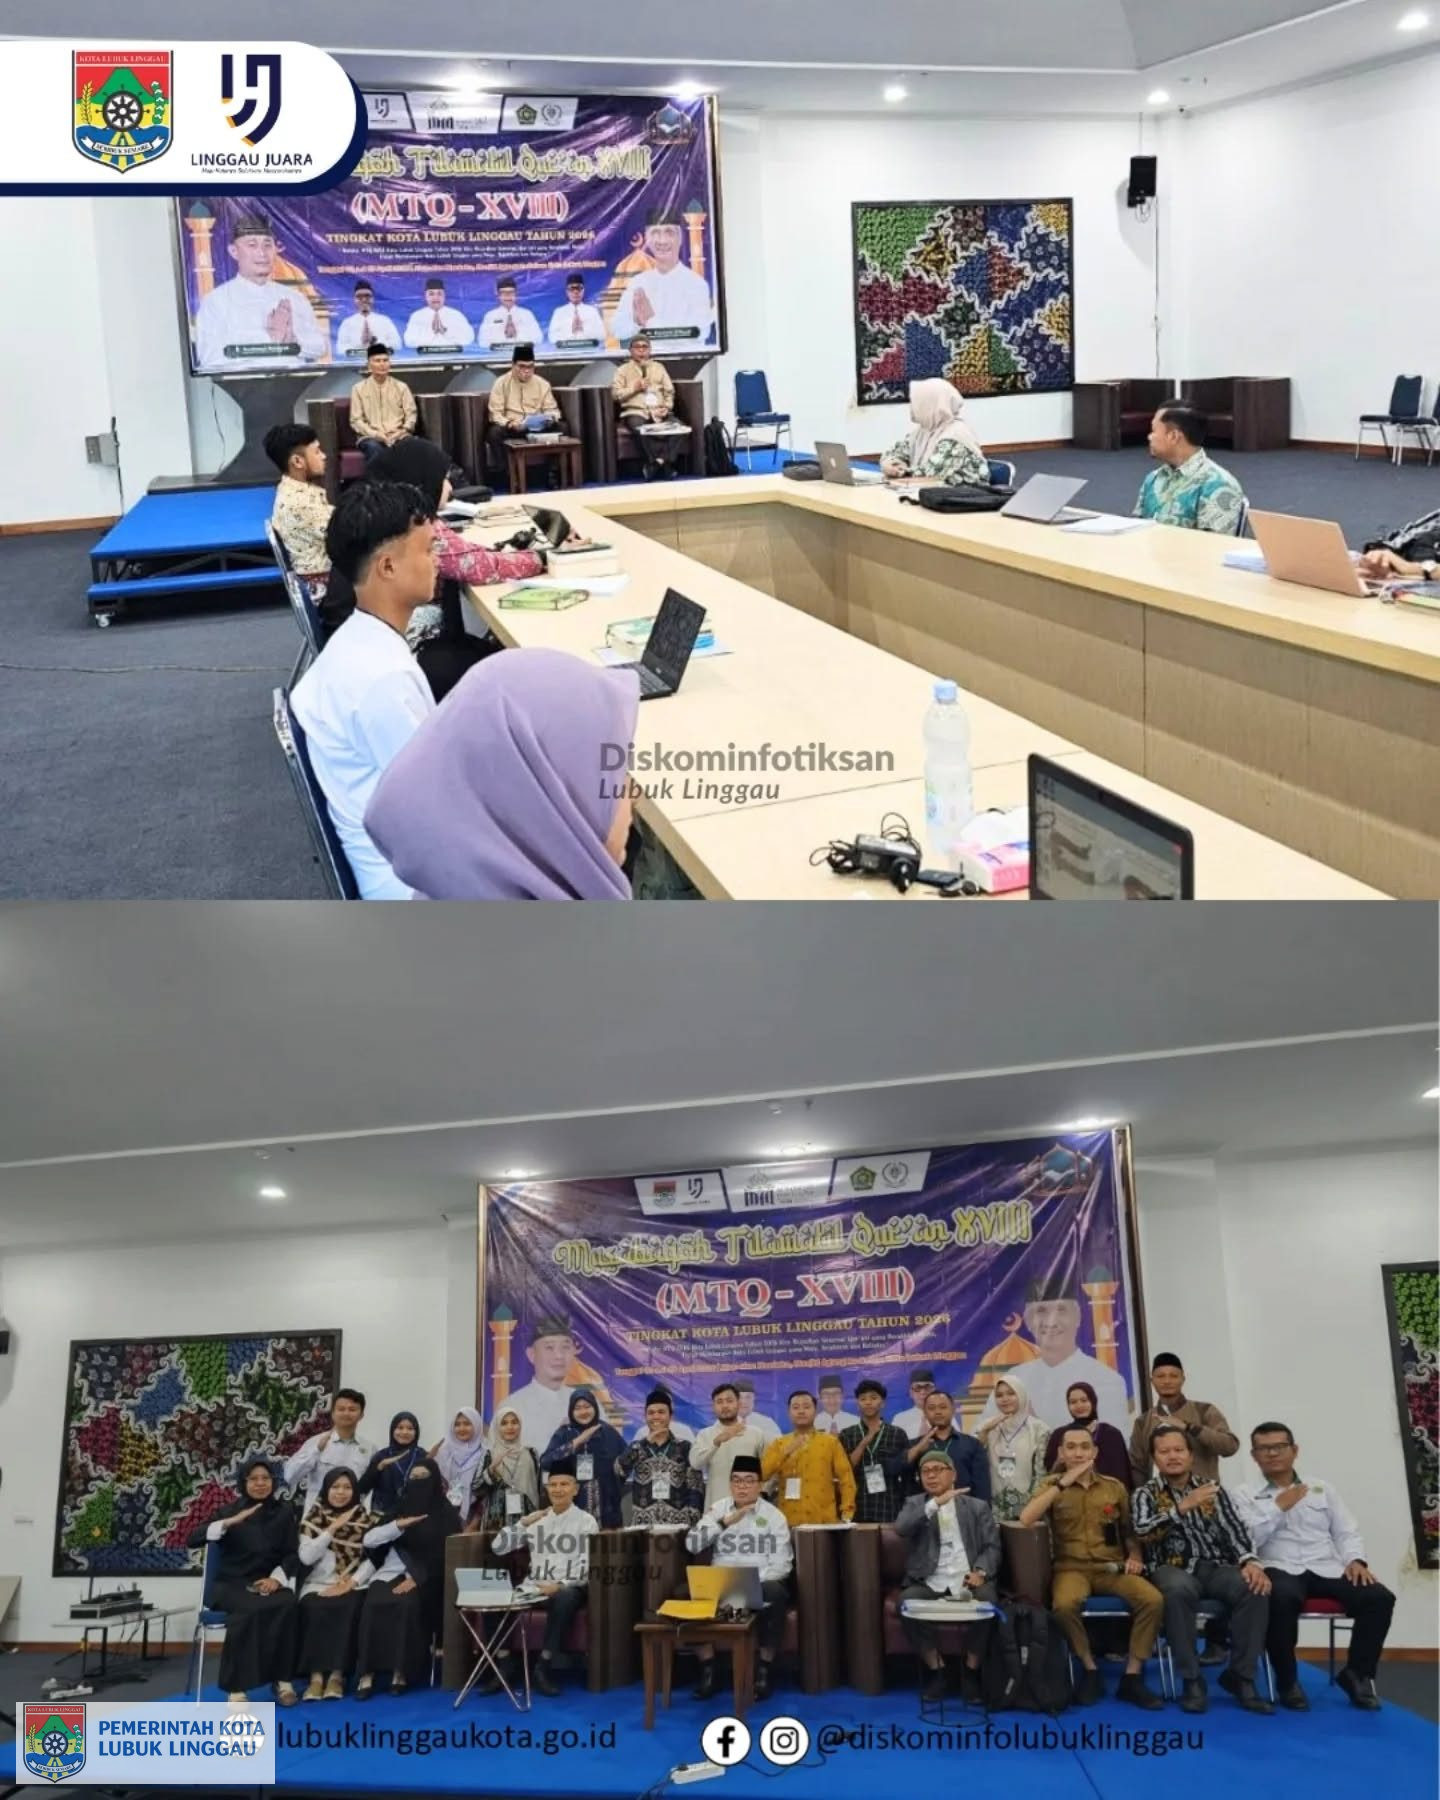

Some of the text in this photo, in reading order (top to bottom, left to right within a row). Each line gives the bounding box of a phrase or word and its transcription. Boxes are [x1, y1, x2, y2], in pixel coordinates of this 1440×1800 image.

[595, 145, 652, 180] XVIII
[326, 232, 383, 243] TINGKAT
[387, 232, 420, 243] KOTA
[422, 230, 465, 242] LUBUK
[469, 230, 523, 242] LINGGAU
[526, 229, 566, 241] TAHUN
[952, 1198, 1033, 1247] XVIII
[626, 1312, 952, 1341] TINGKAT KOTA LUBUK LINGGAU TAHUN 2026
